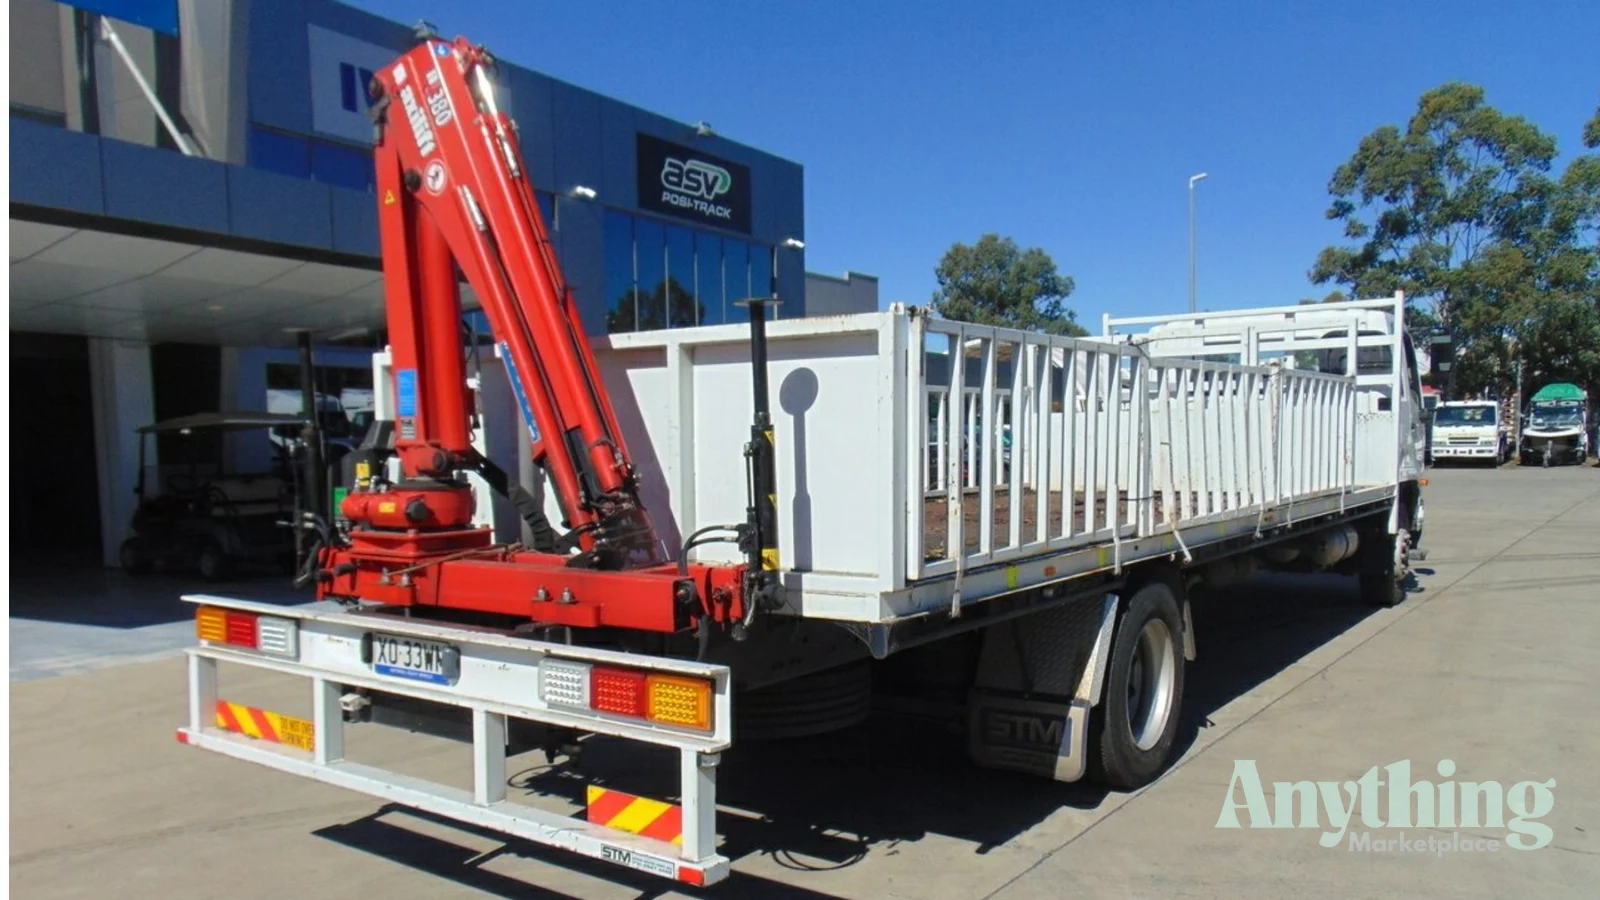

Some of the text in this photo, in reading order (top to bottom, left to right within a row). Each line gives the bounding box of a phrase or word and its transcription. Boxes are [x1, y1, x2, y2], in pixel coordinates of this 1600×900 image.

[427, 88, 452, 127] 380
[661, 191, 732, 220] POSI-TRACK
[987, 713, 1063, 745] STM
[602, 846, 631, 865] STM
